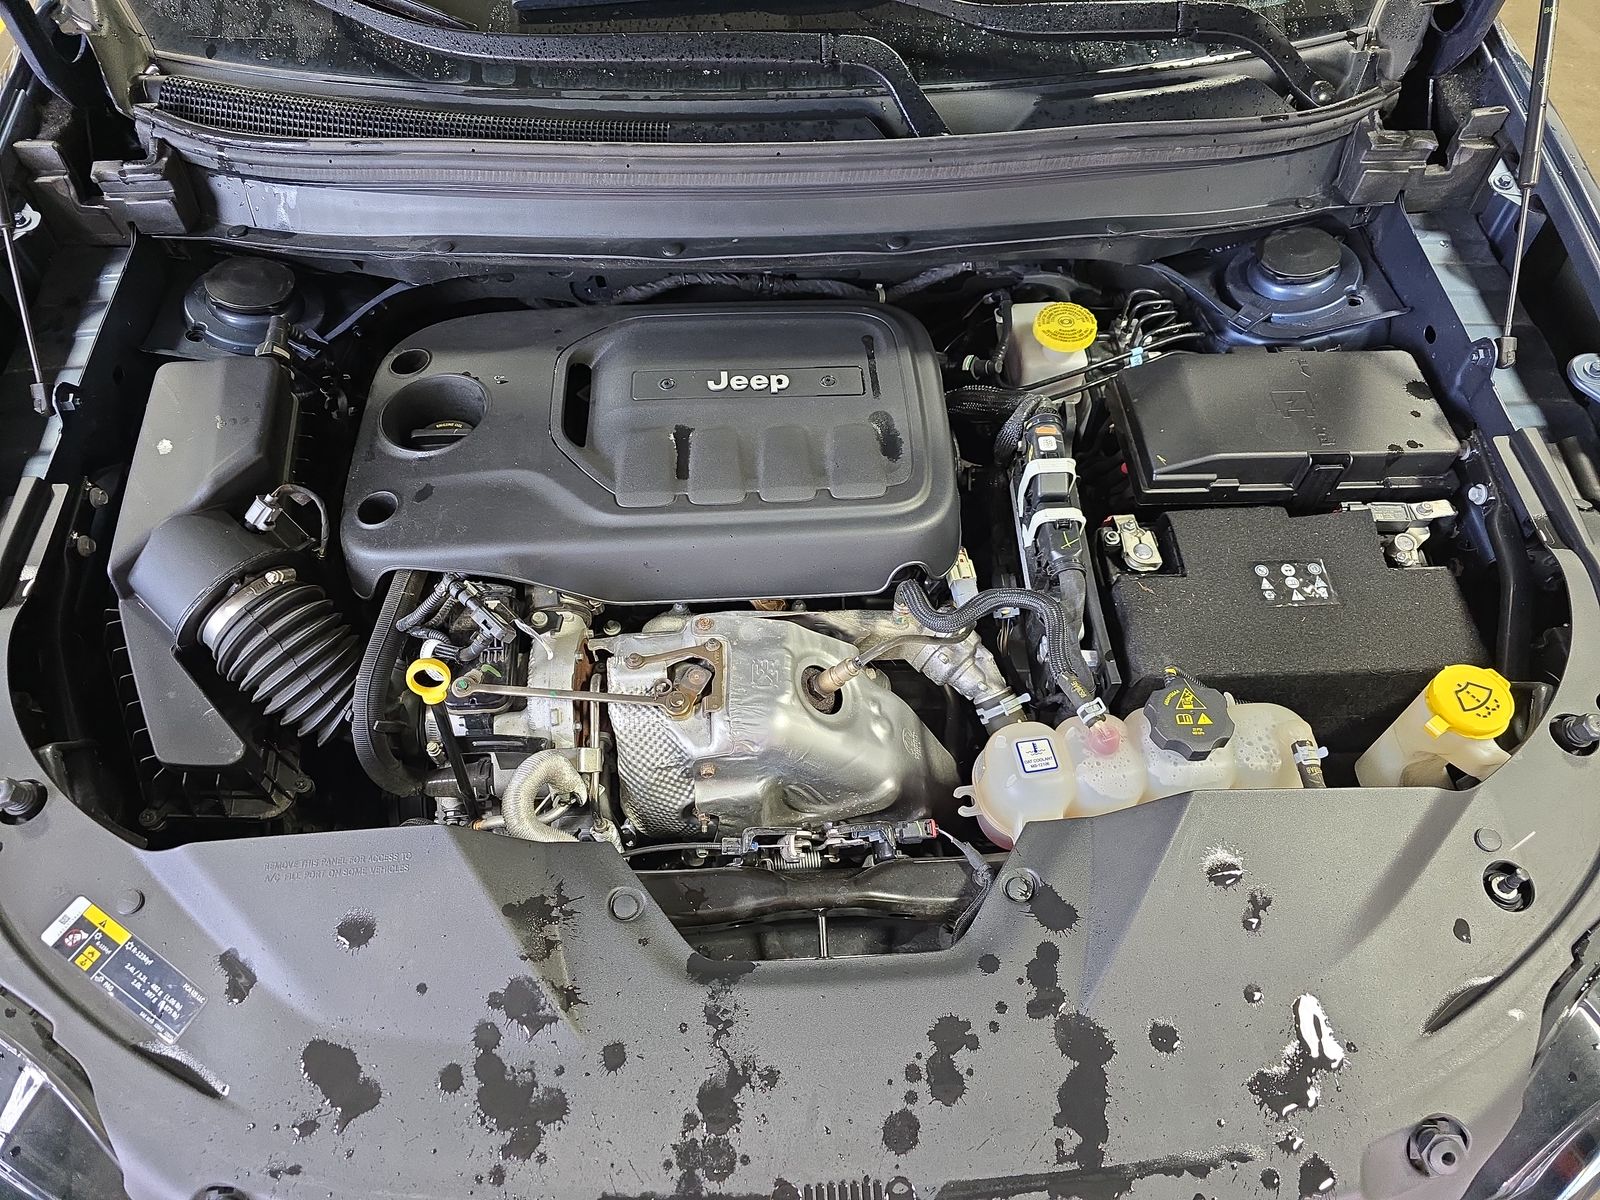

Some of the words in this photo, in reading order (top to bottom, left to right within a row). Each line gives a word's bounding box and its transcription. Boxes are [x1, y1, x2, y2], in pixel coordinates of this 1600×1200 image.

[707, 371, 790, 394] Jeep
[264, 861, 299, 871] REMOVE
[302, 859, 318, 868] THIS
[321, 858, 346, 867] PANEL
[349, 855, 366, 864] FOR
[368, 852, 399, 862] ACCESS
[401, 851, 412, 860] TO
[264, 874, 280, 883] A/C
[284, 872, 301, 881] FILL
[304, 870, 325, 879] PORT
[328, 868, 340, 878] ON
[342, 867, 367, 876] SOME
[370, 864, 410, 874] VEHICLES
[131, 948, 154, 966] R-1234yf
[102, 981, 114, 992] PAG
